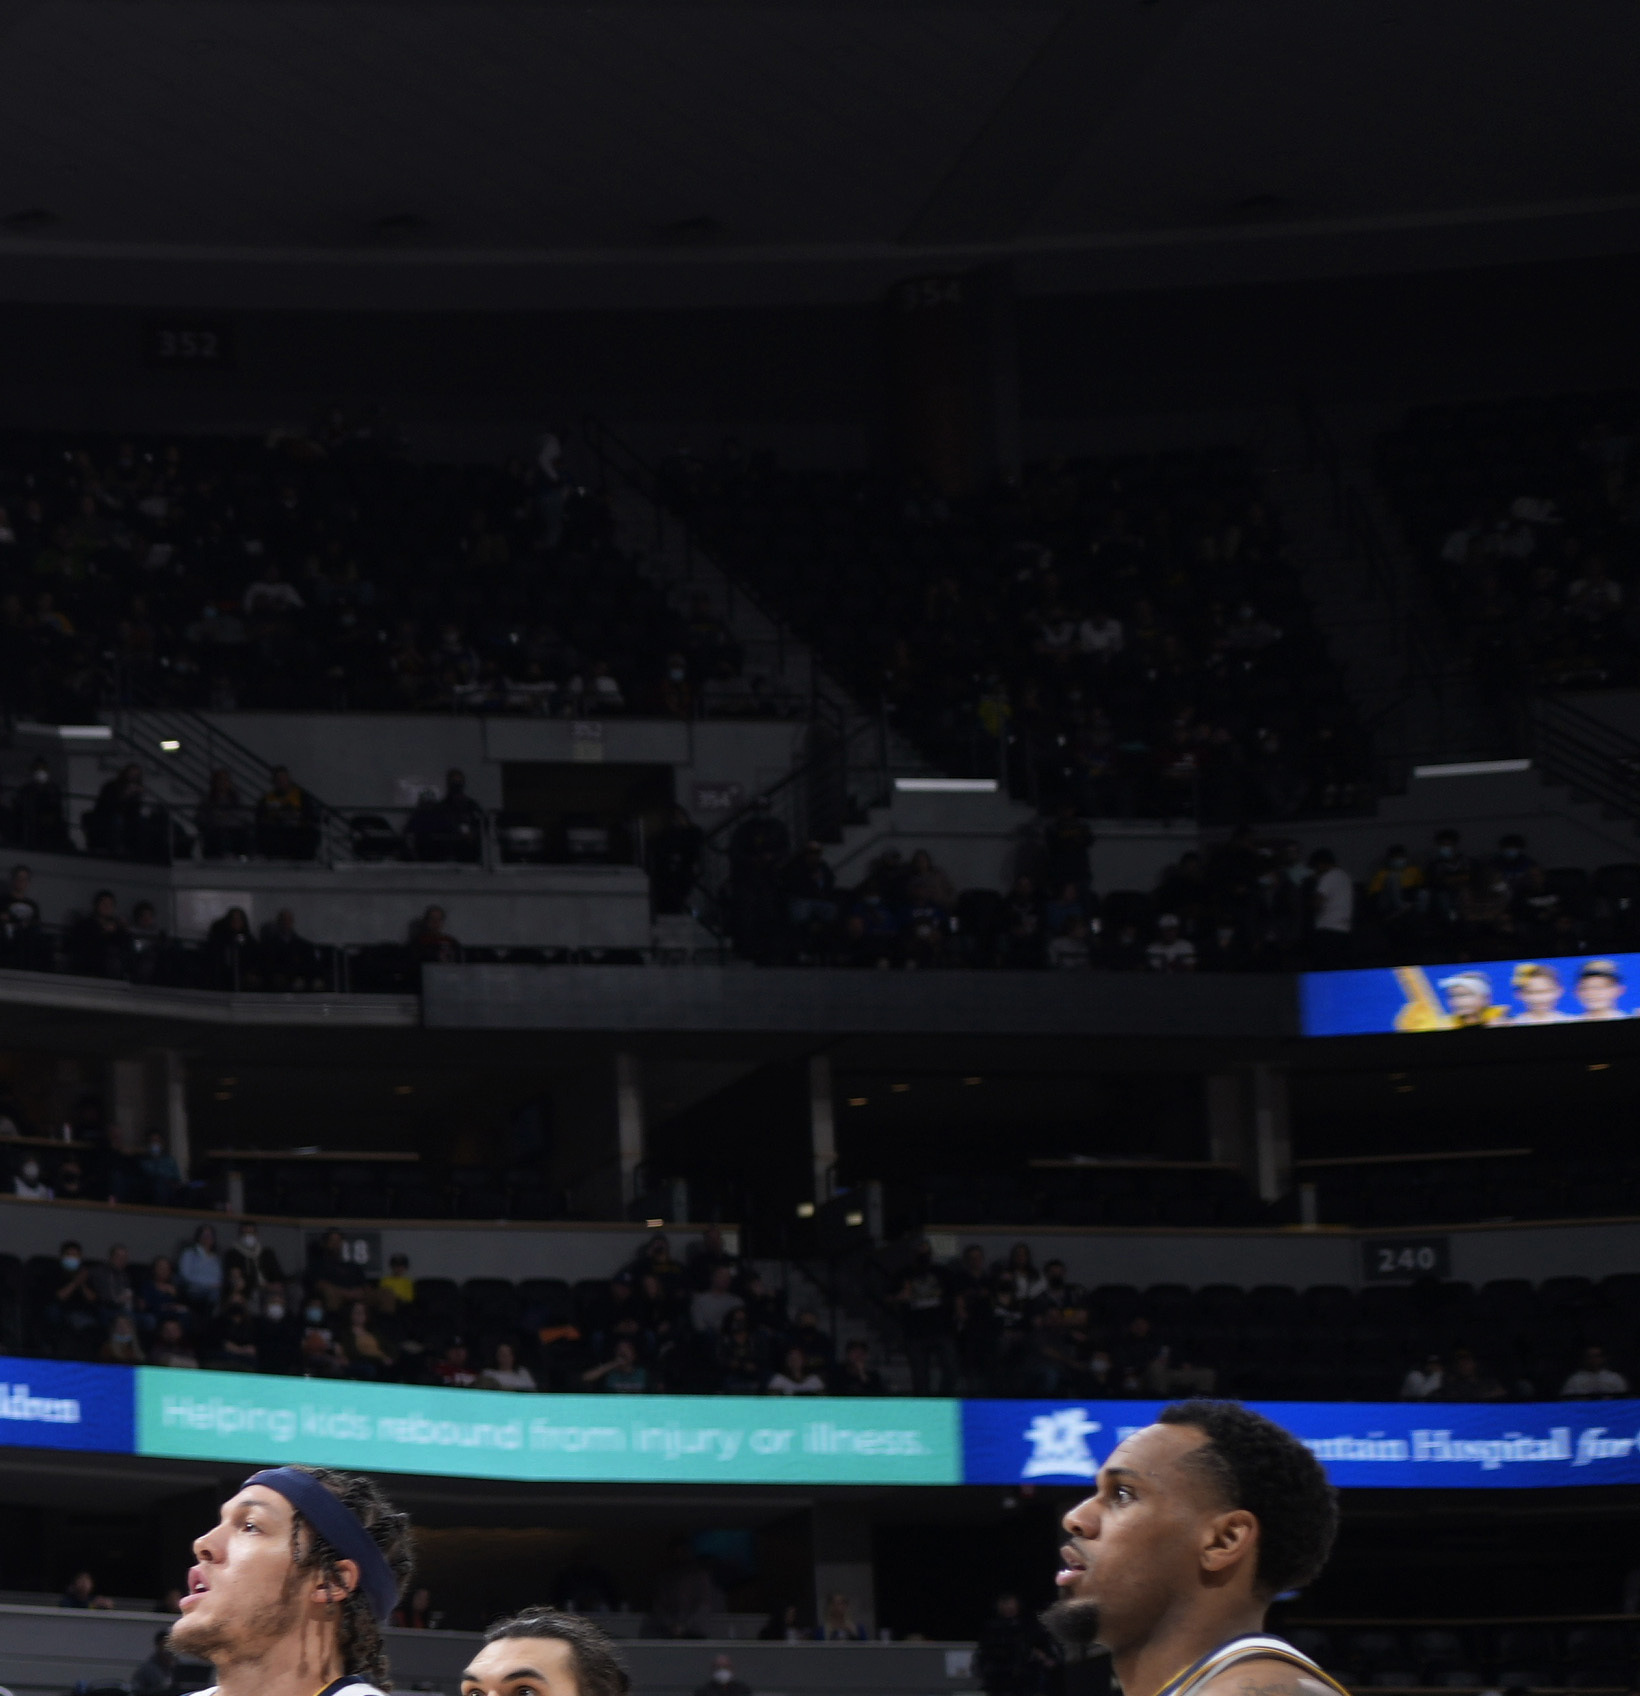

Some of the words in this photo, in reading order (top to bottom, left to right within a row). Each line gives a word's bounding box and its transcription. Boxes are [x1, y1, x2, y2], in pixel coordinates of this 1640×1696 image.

[1377, 1246, 1437, 1273] 240
[160, 1394, 298, 1443] Helping
[300, 1404, 372, 1441] kids
[375, 1412, 524, 1450] rebound
[528, 1416, 627, 1454] from
[631, 1420, 744, 1462] injury
[748, 1427, 798, 1455] or
[1410, 1426, 1572, 1470] Hospital
[1571, 1426, 1634, 1468] for
